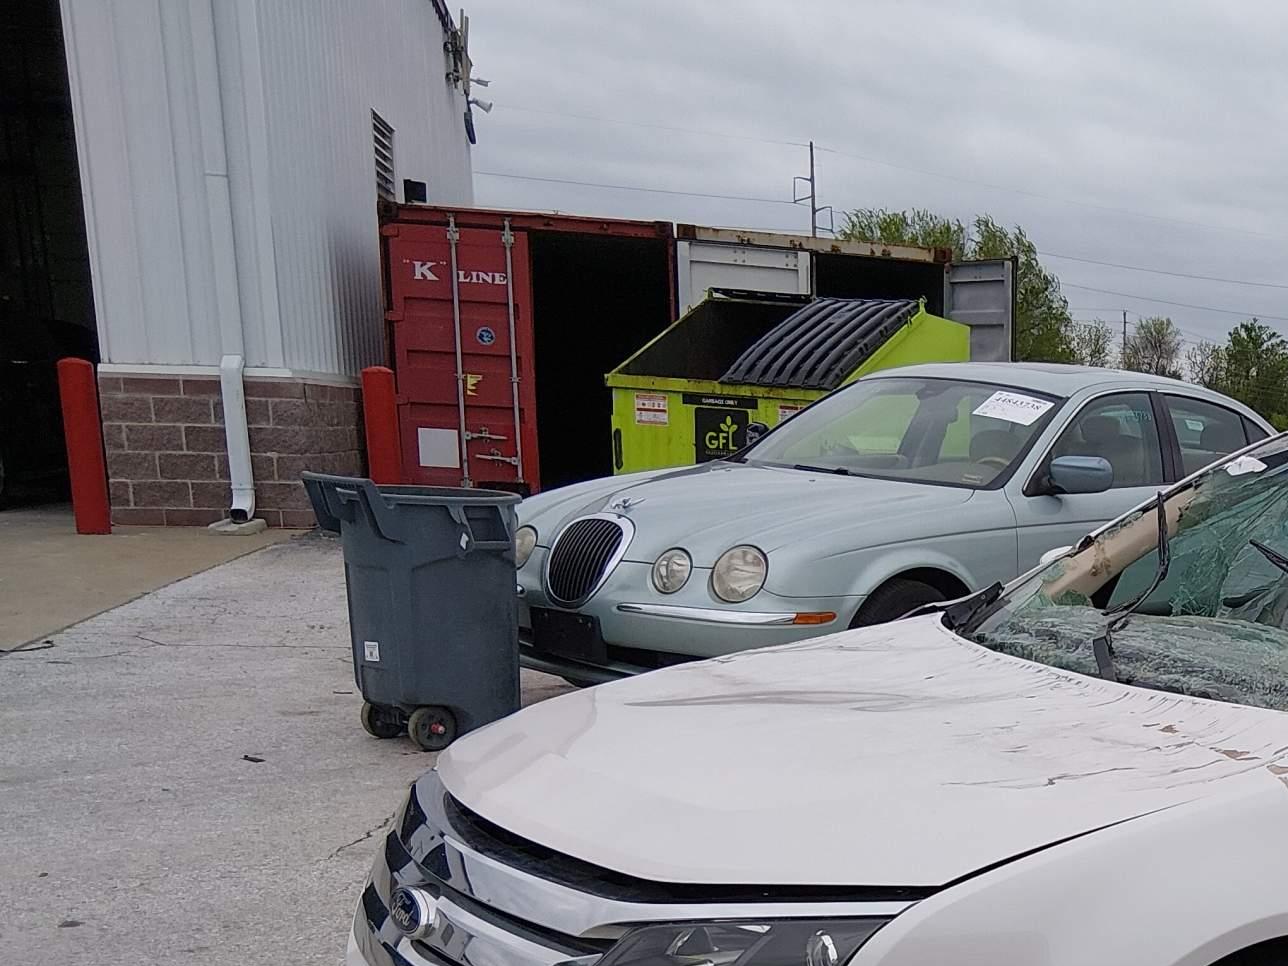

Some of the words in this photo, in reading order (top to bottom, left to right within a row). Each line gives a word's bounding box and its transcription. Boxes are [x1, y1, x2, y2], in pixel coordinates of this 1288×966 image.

[458, 270, 508, 285] LINE
[705, 428, 738, 450] GFL
[391, 891, 415, 928] Ford
